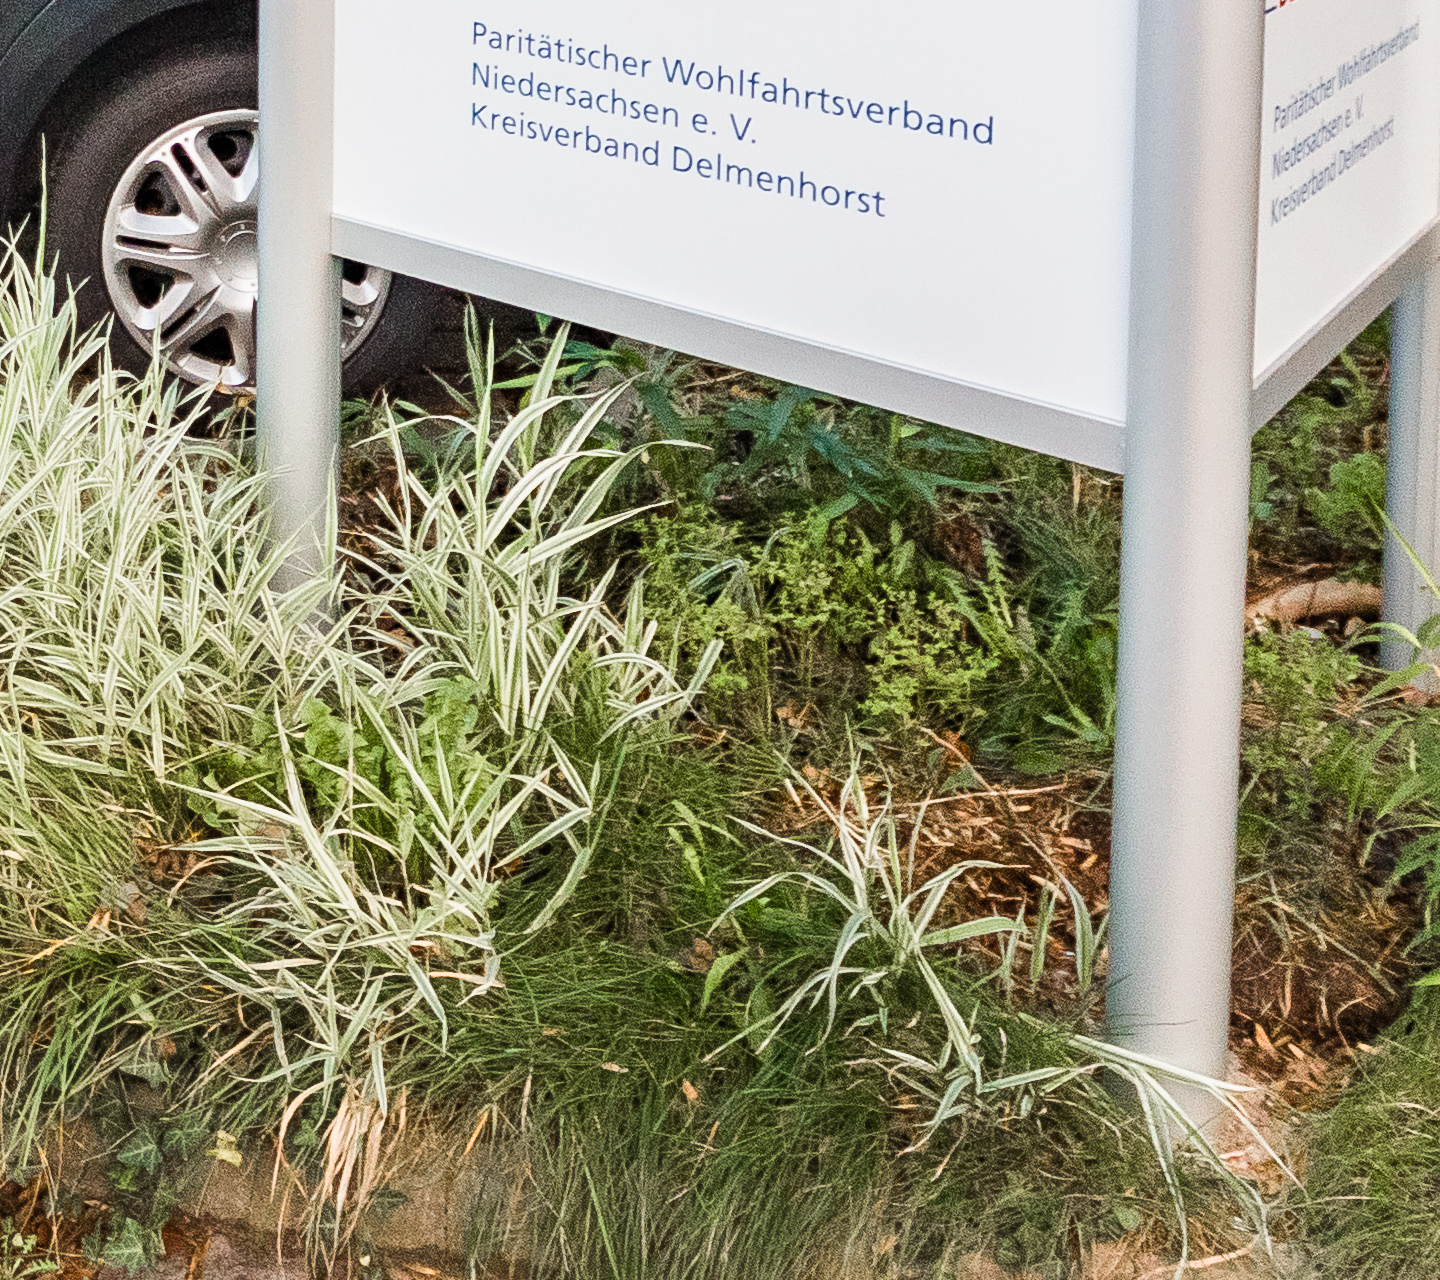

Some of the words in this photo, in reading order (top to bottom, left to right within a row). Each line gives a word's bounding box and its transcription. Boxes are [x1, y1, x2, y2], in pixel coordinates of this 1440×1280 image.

[472, 21, 651, 78] Paritätischer
[662, 56, 994, 145] Wohlfahrtsverband
[472, 62, 679, 128] Niedersachsen
[692, 112, 717, 136] e.
[730, 113, 756, 144] V.
[471, 102, 660, 167] Kreisverband
[672, 145, 885, 218] Delmenhorst
